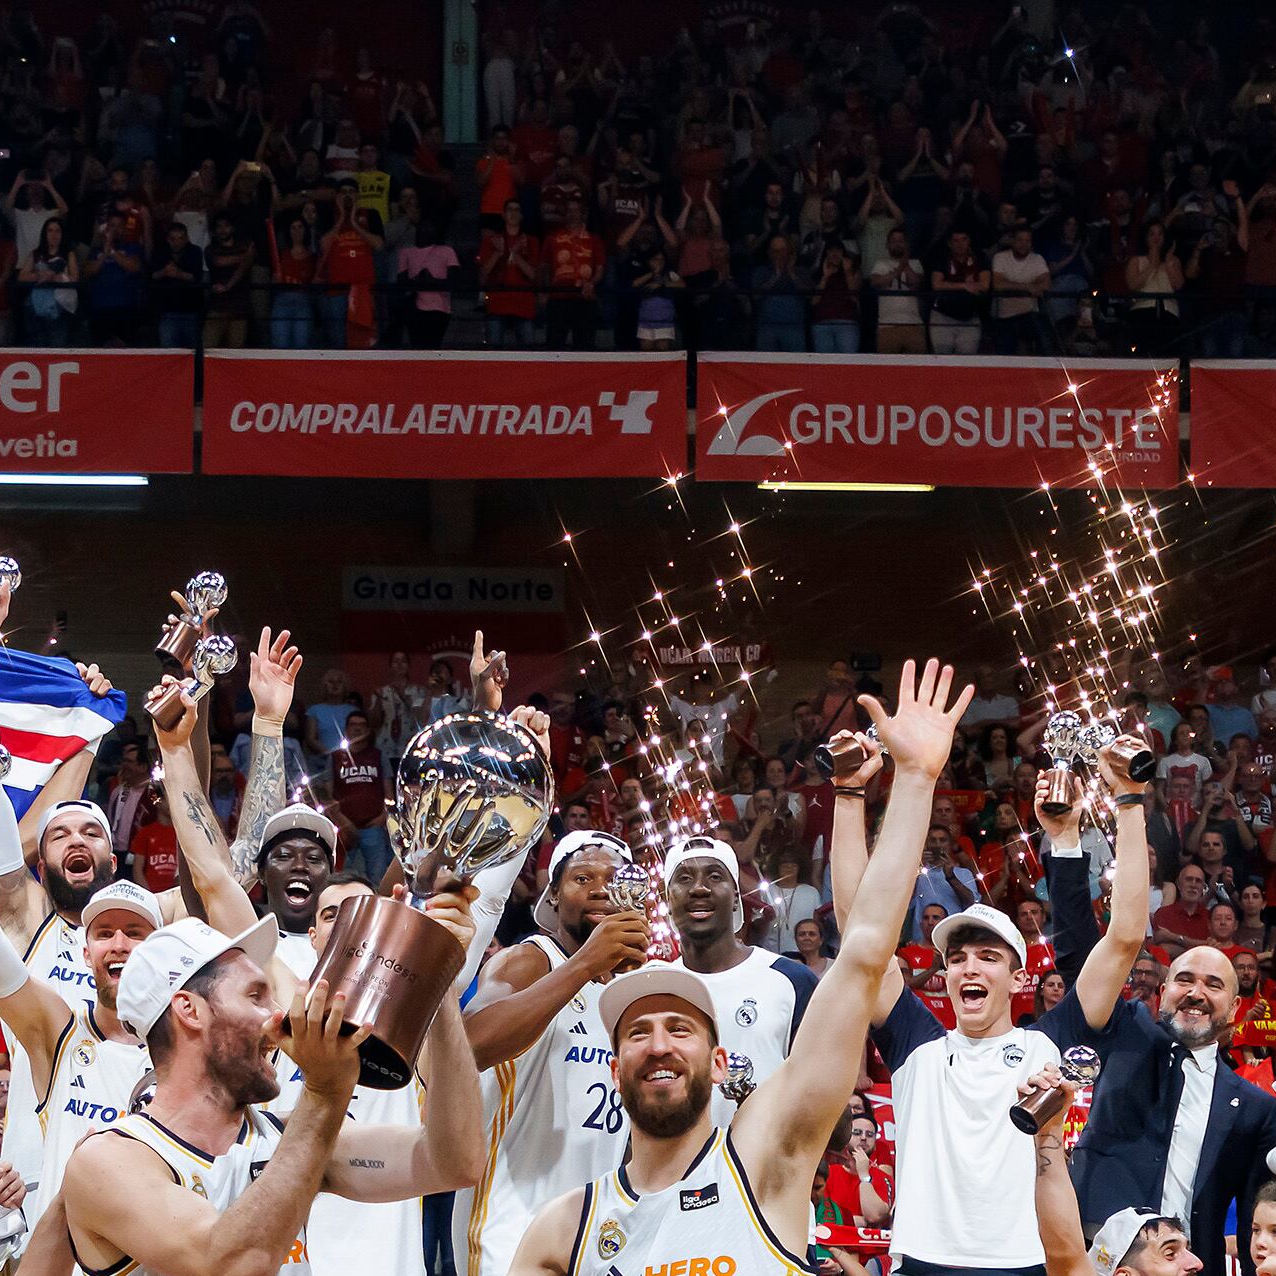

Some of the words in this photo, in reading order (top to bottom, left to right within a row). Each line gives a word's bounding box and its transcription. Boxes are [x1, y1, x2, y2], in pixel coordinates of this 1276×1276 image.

[230, 401, 593, 435] COMPRALAENTRADA
[789, 403, 1161, 450] GRUPOSURESTE
[354, 577, 453, 600] Grada
[469, 578, 553, 600] Norte
[339, 765, 379, 779] UCAM
[65, 1098, 128, 1124] AUTO
[581, 1083, 624, 1134] 28
